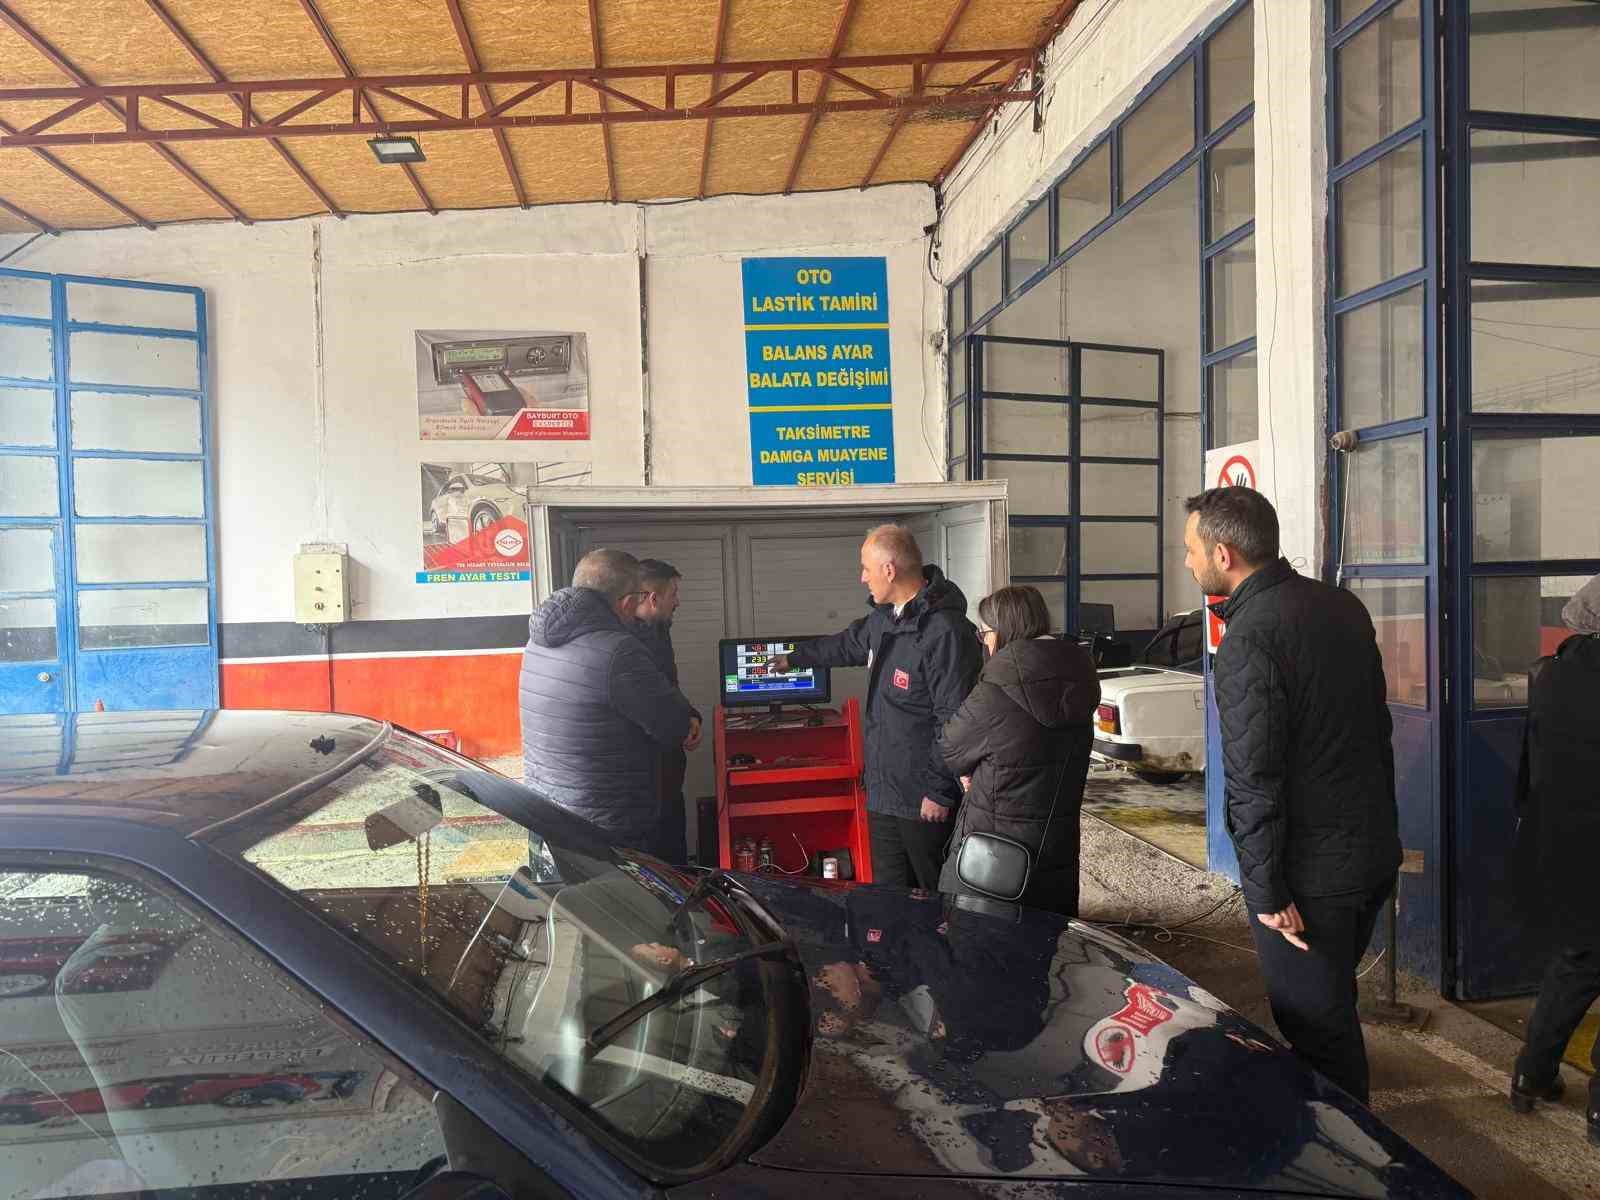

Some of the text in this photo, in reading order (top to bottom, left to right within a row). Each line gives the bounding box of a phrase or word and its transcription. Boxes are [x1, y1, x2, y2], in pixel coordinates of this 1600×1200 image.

[796, 269, 832, 285] OTO
[752, 292, 878, 312] LASTİK TAMİRİ
[762, 344, 874, 361] BALANS AYAR
[750, 368, 889, 390] BALATA DEĞİŞİMİ
[563, 412, 579, 420] OTO
[776, 424, 871, 441] TAKSİMETRE
[760, 447, 888, 464] DAMGA MUAYENE
[796, 468, 855, 486] SERVİSİ
[427, 574, 456, 583] FREN
[459, 573, 485, 582] AYAR
